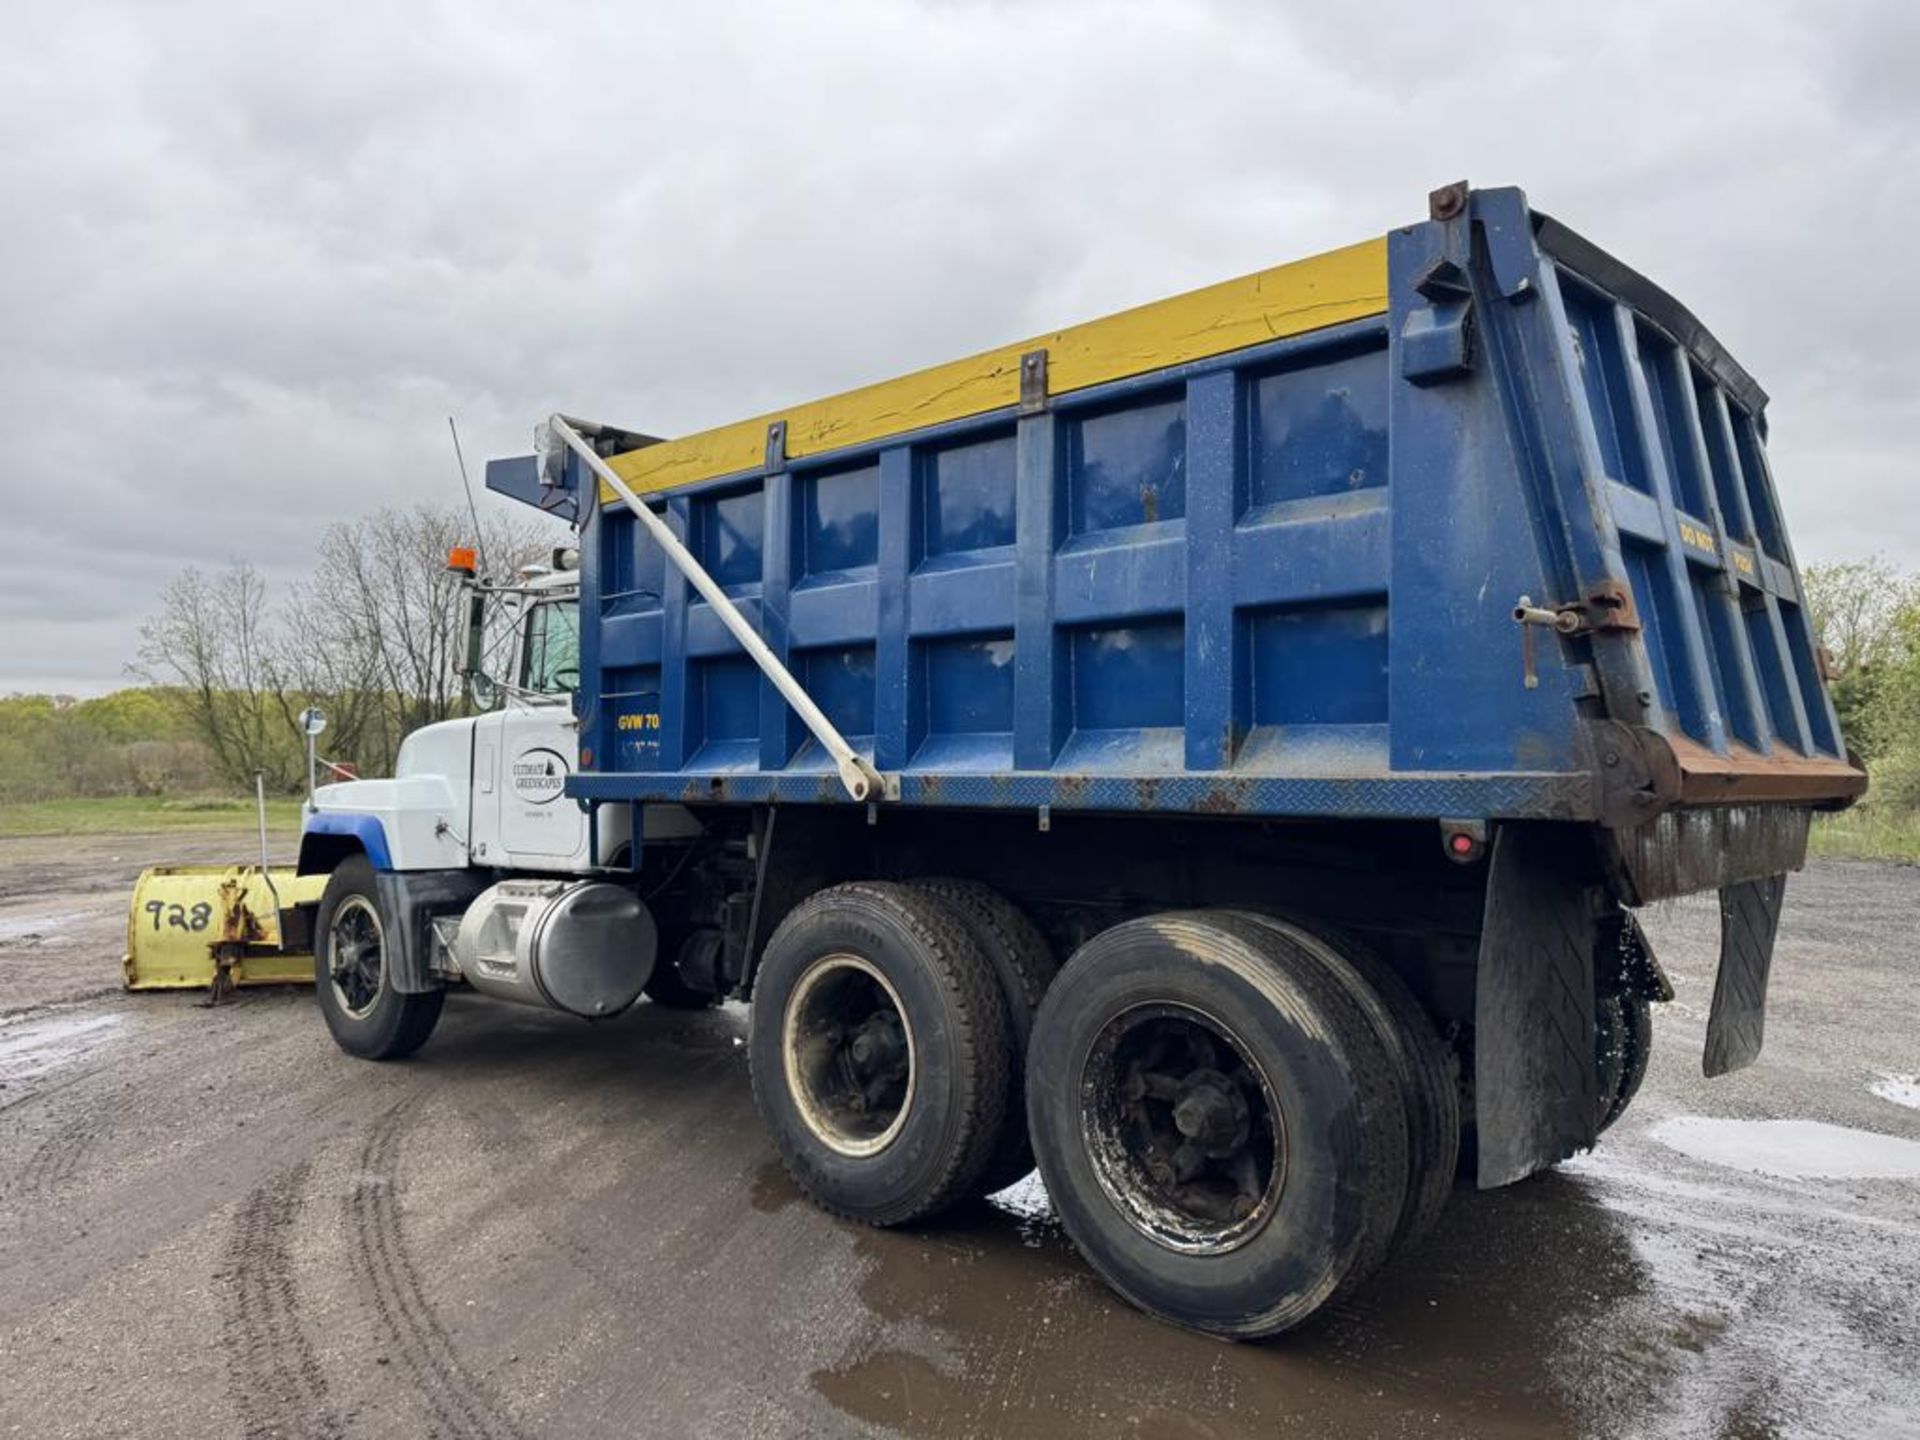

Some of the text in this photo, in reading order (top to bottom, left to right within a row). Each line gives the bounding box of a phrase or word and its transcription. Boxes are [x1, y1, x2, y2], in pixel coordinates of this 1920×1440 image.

[1681, 523, 1696, 546] DO
[618, 714, 643, 730] GVW
[145, 899, 213, 932] 928
